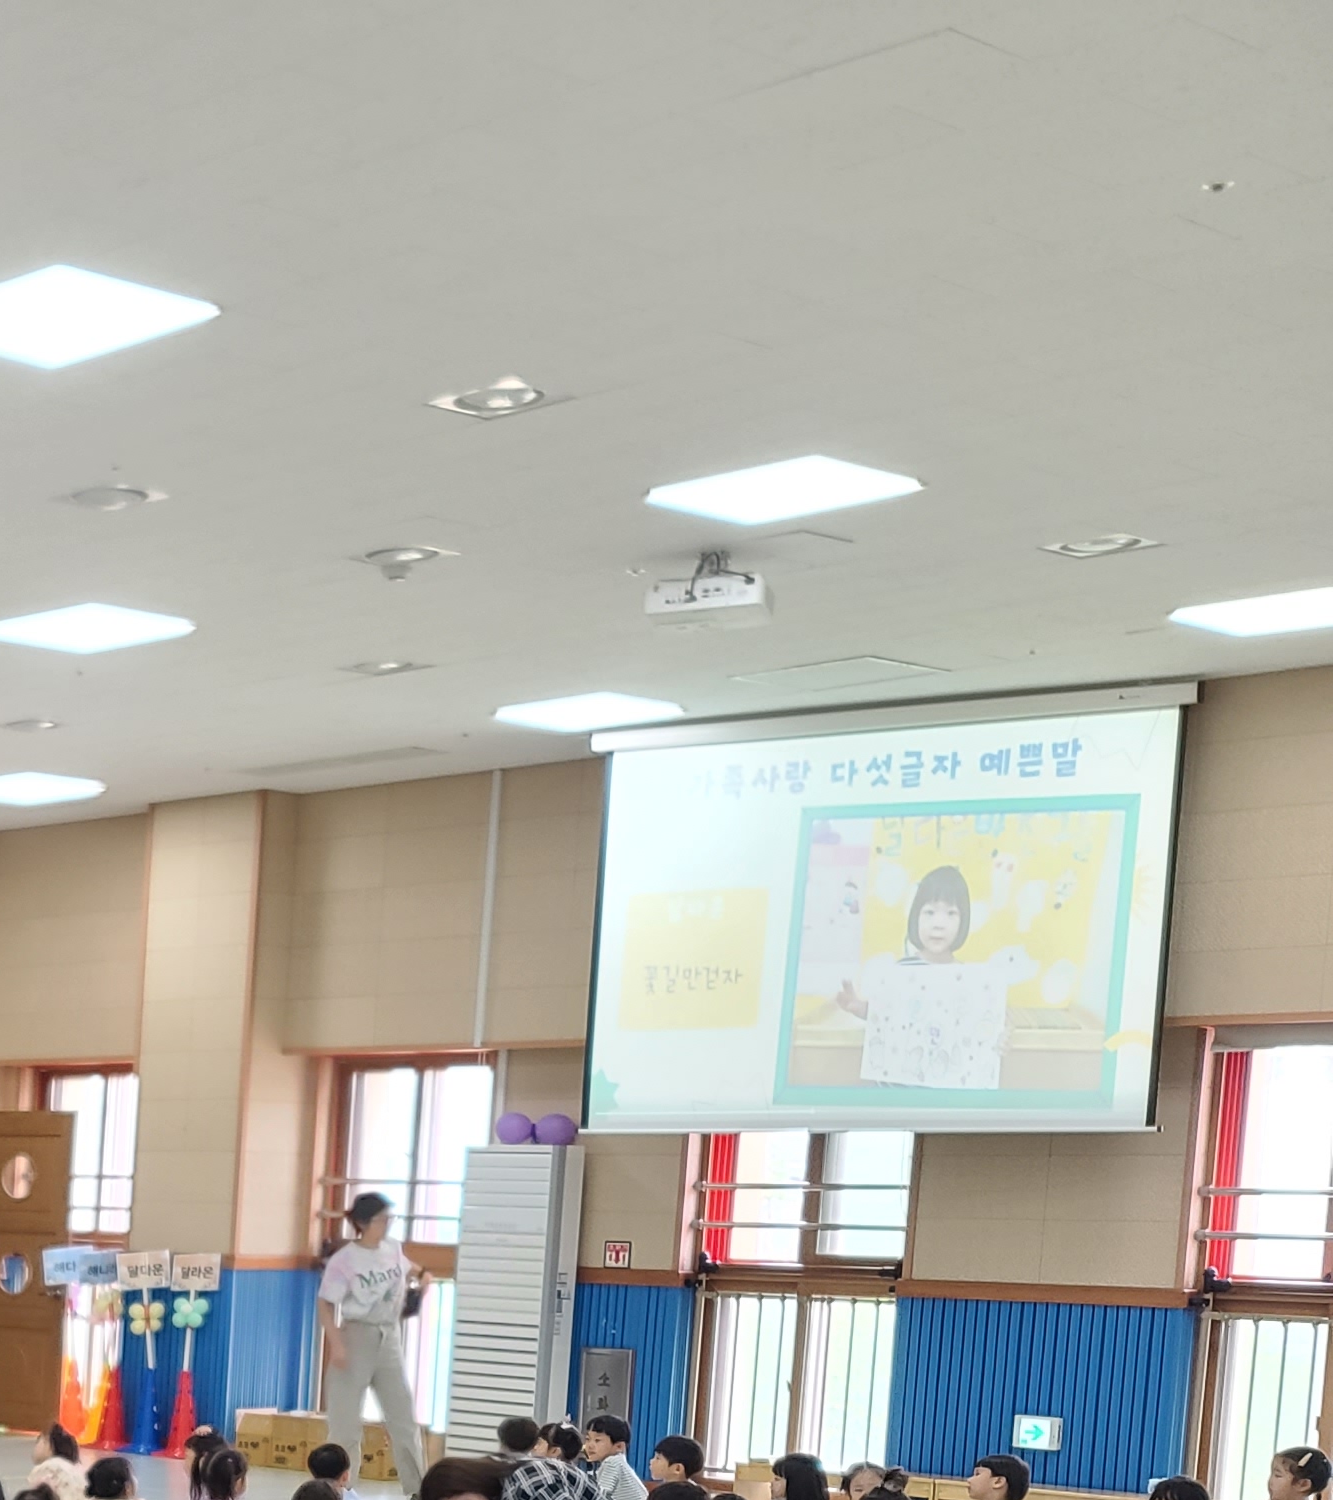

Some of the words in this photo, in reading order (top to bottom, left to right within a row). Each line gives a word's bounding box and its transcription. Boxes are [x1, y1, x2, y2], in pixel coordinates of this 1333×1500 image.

[830, 750, 962, 789] 다섯글자
[979, 737, 1083, 779] 예쁜말
[644, 964, 744, 996] 꽃길만걷자
